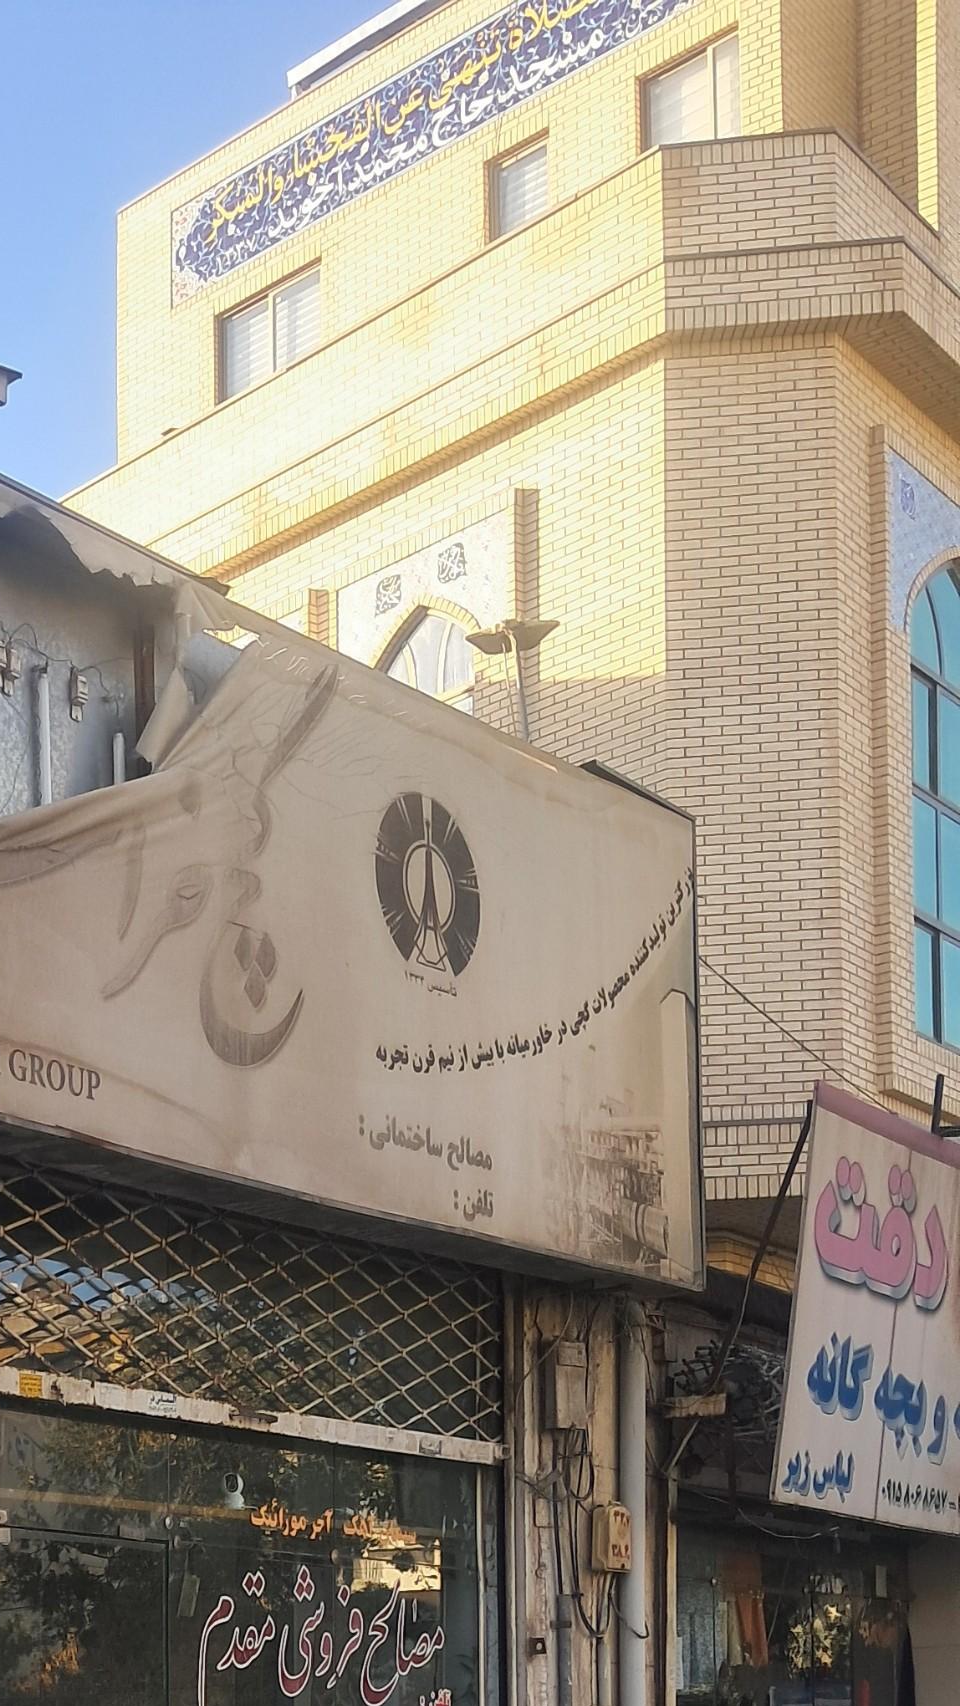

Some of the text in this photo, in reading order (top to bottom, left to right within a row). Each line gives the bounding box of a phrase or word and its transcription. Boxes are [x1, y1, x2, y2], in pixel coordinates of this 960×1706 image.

[558, 1020, 567, 1045] در
[375, 1044, 409, 1070] تجربه
[412, 1044, 436, 1073] قرن
[439, 1045, 454, 1073] نیم
[458, 1043, 468, 1071] از
[471, 1042, 493, 1070] بیش
[494, 1037, 505, 1064] با
[8, 1048, 101, 1101] GROUP
[447, 1135, 492, 1171] مصالح
[814, 1156, 948, 1312] دقت
[813, 1450, 855, 1504] لباس
[278, 1564, 364, 1698] فروشی
